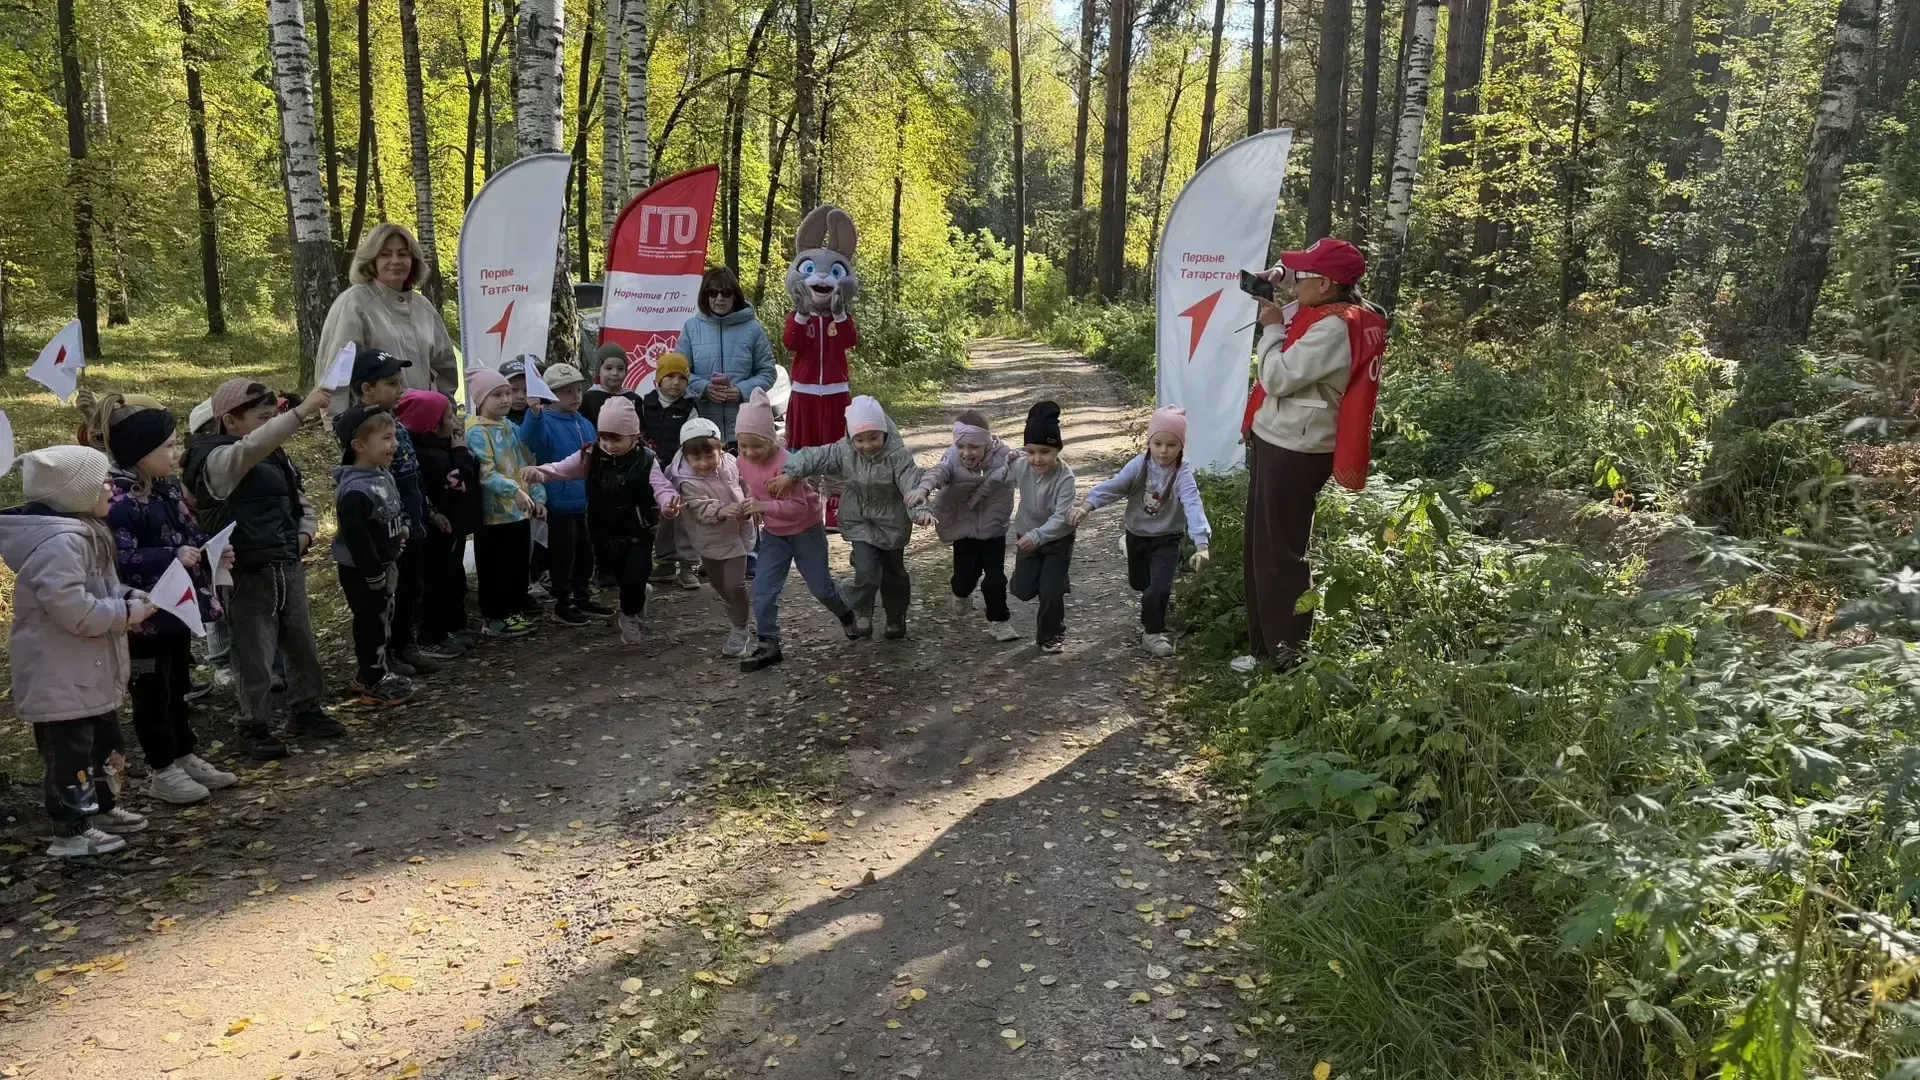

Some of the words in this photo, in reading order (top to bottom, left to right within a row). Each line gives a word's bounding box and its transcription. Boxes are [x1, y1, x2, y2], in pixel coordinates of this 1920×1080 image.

[639, 204, 698, 245] ГТО
[1182, 252, 1225, 265] Первые
[1180, 268, 1240, 282] Татарстан
[613, 287, 662, 301] Норматив
[663, 291, 680, 301] ГТО
[636, 305, 665, 315] норма
[666, 305, 696, 314] жизни!
